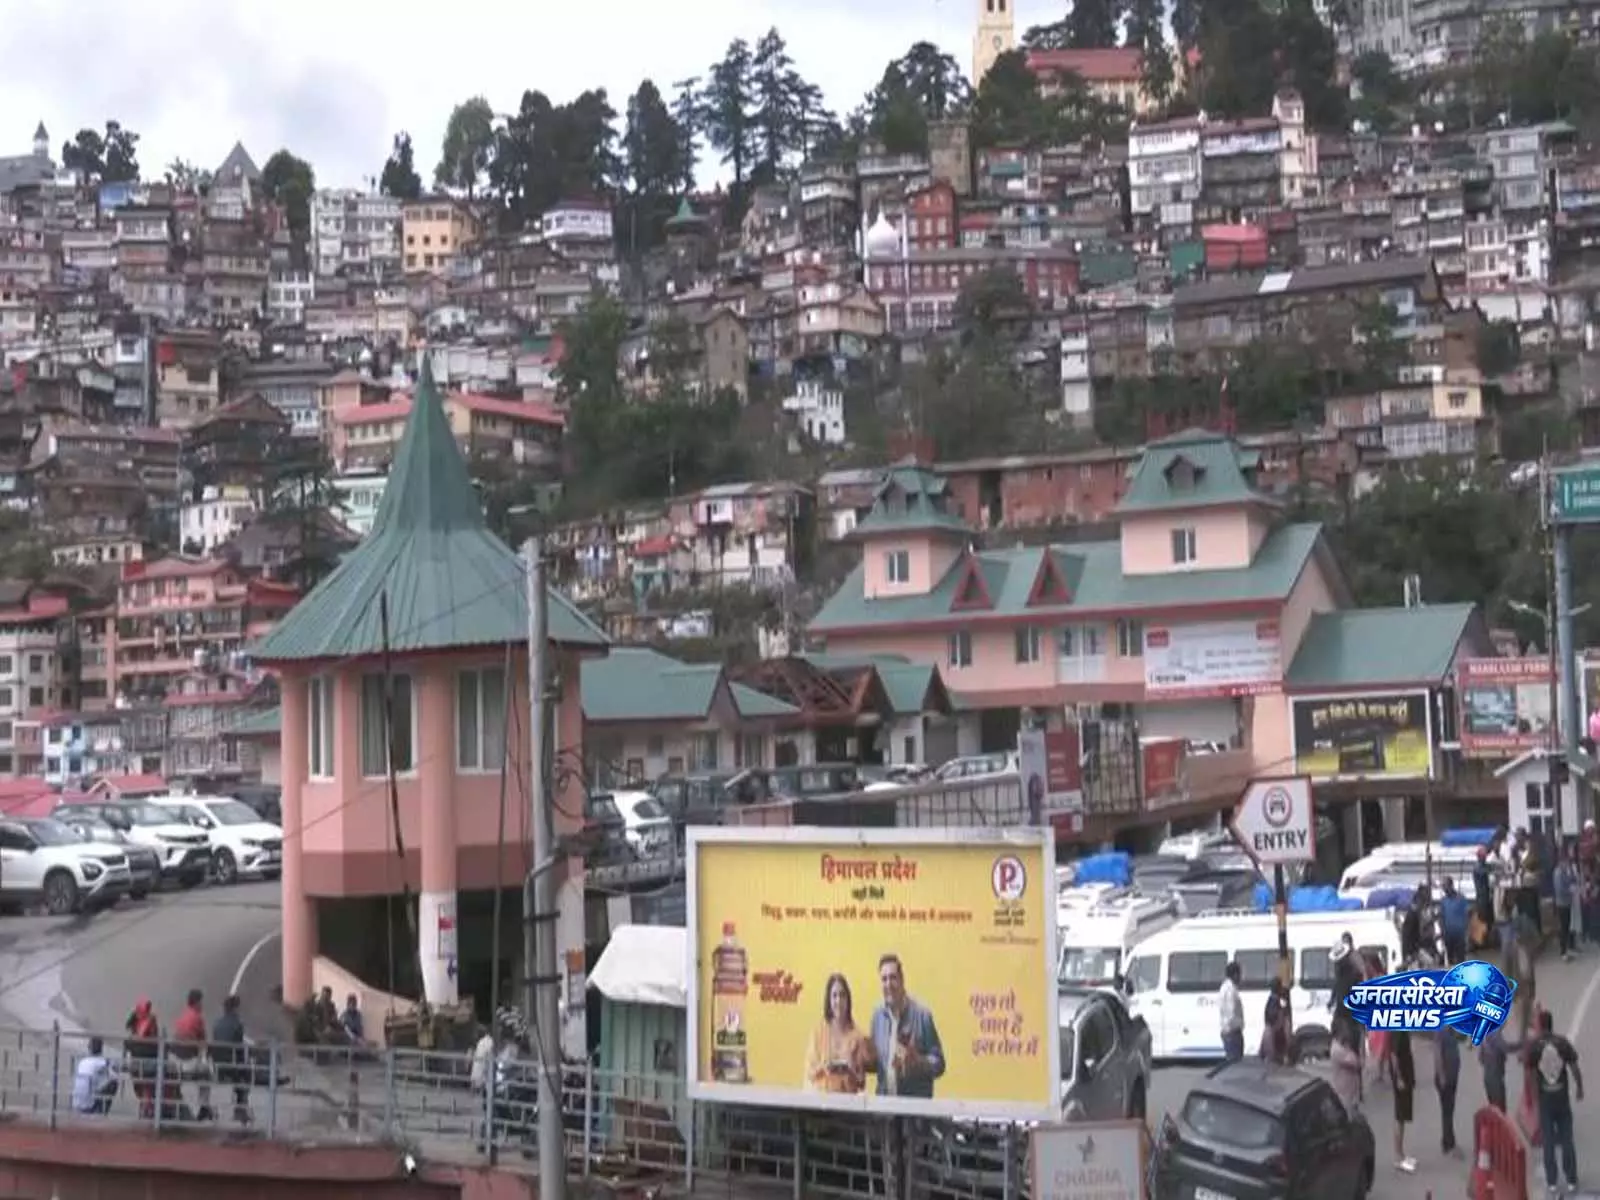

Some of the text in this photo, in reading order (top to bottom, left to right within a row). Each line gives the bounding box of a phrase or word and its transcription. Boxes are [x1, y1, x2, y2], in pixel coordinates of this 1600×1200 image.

[1253, 829, 1307, 851] ENTRY
[820, 853, 917, 883] हिमाचल प्रदेश
[1054, 1168, 1122, 1188] CHADHA
